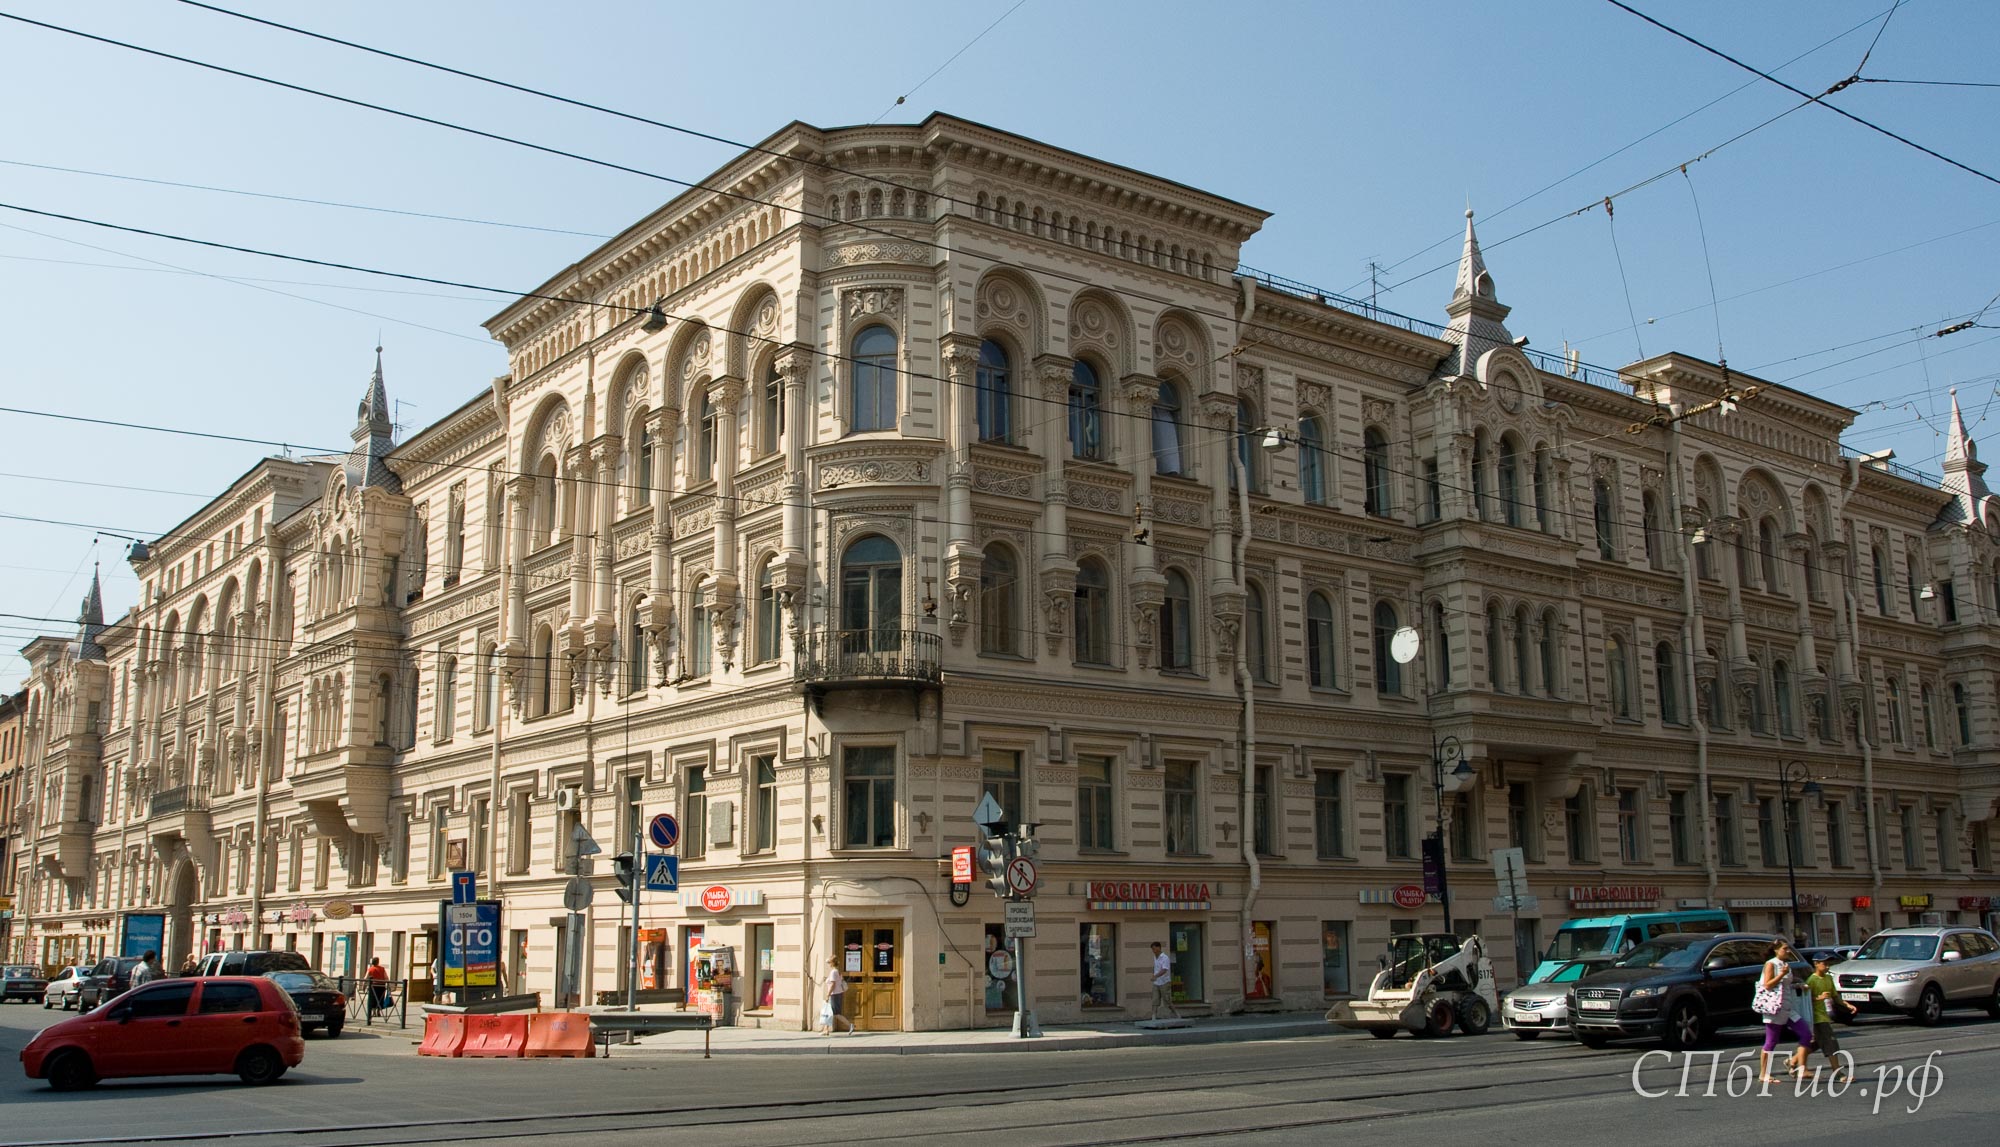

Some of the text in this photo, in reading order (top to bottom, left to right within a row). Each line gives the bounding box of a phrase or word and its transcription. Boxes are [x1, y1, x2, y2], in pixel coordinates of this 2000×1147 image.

[1089, 882, 1210, 899] КОСМЕТИКА
[1400, 890, 1424, 898] УЛЫБКА
[1573, 887, 1660, 900] ПАРФЮМЕРИЯ
[450, 929, 493, 946] ОГО
[1478, 969, 1494, 980] S175
